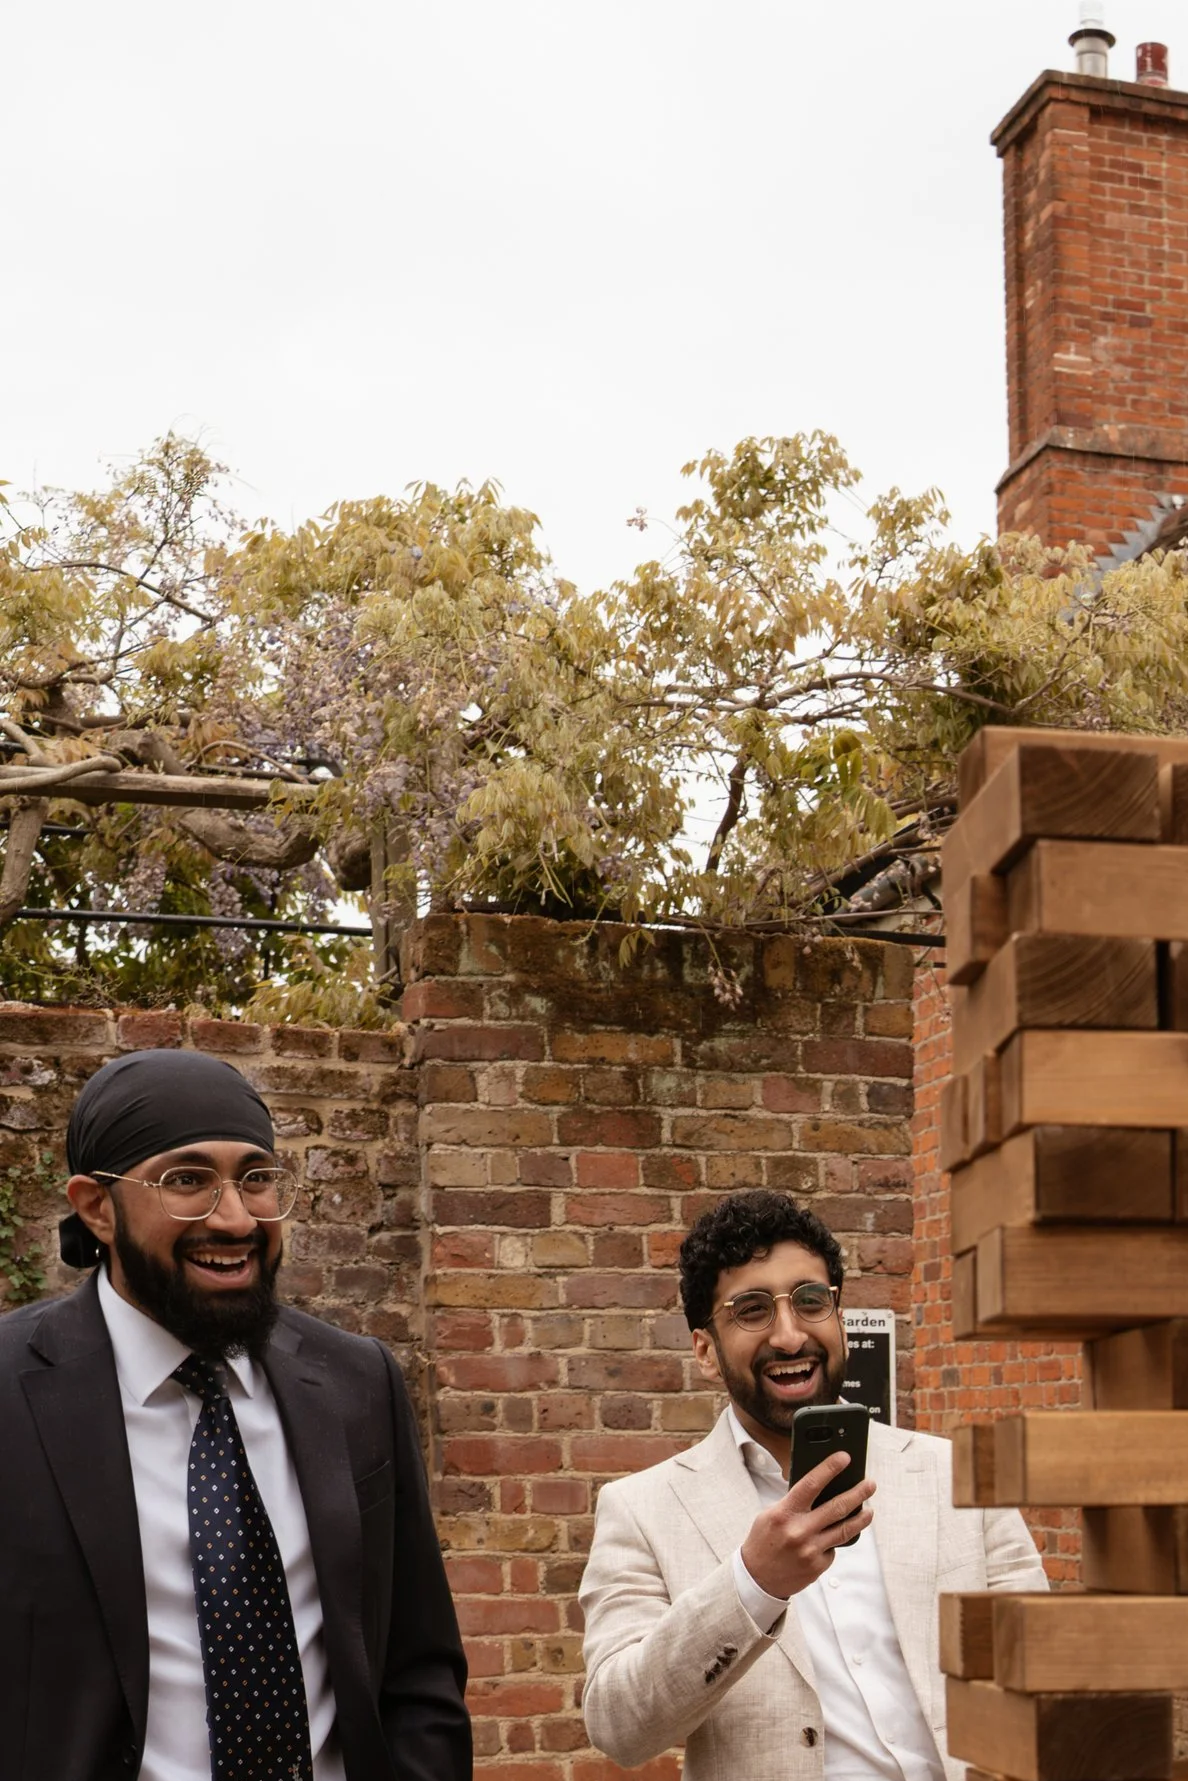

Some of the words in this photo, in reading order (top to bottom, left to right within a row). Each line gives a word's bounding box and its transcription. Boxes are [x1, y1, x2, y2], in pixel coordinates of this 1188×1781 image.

[848, 1340, 860, 1349] es
[861, 1339, 875, 1349] at:
[842, 1380, 861, 1388] mes
[869, 1406, 881, 1414] on
